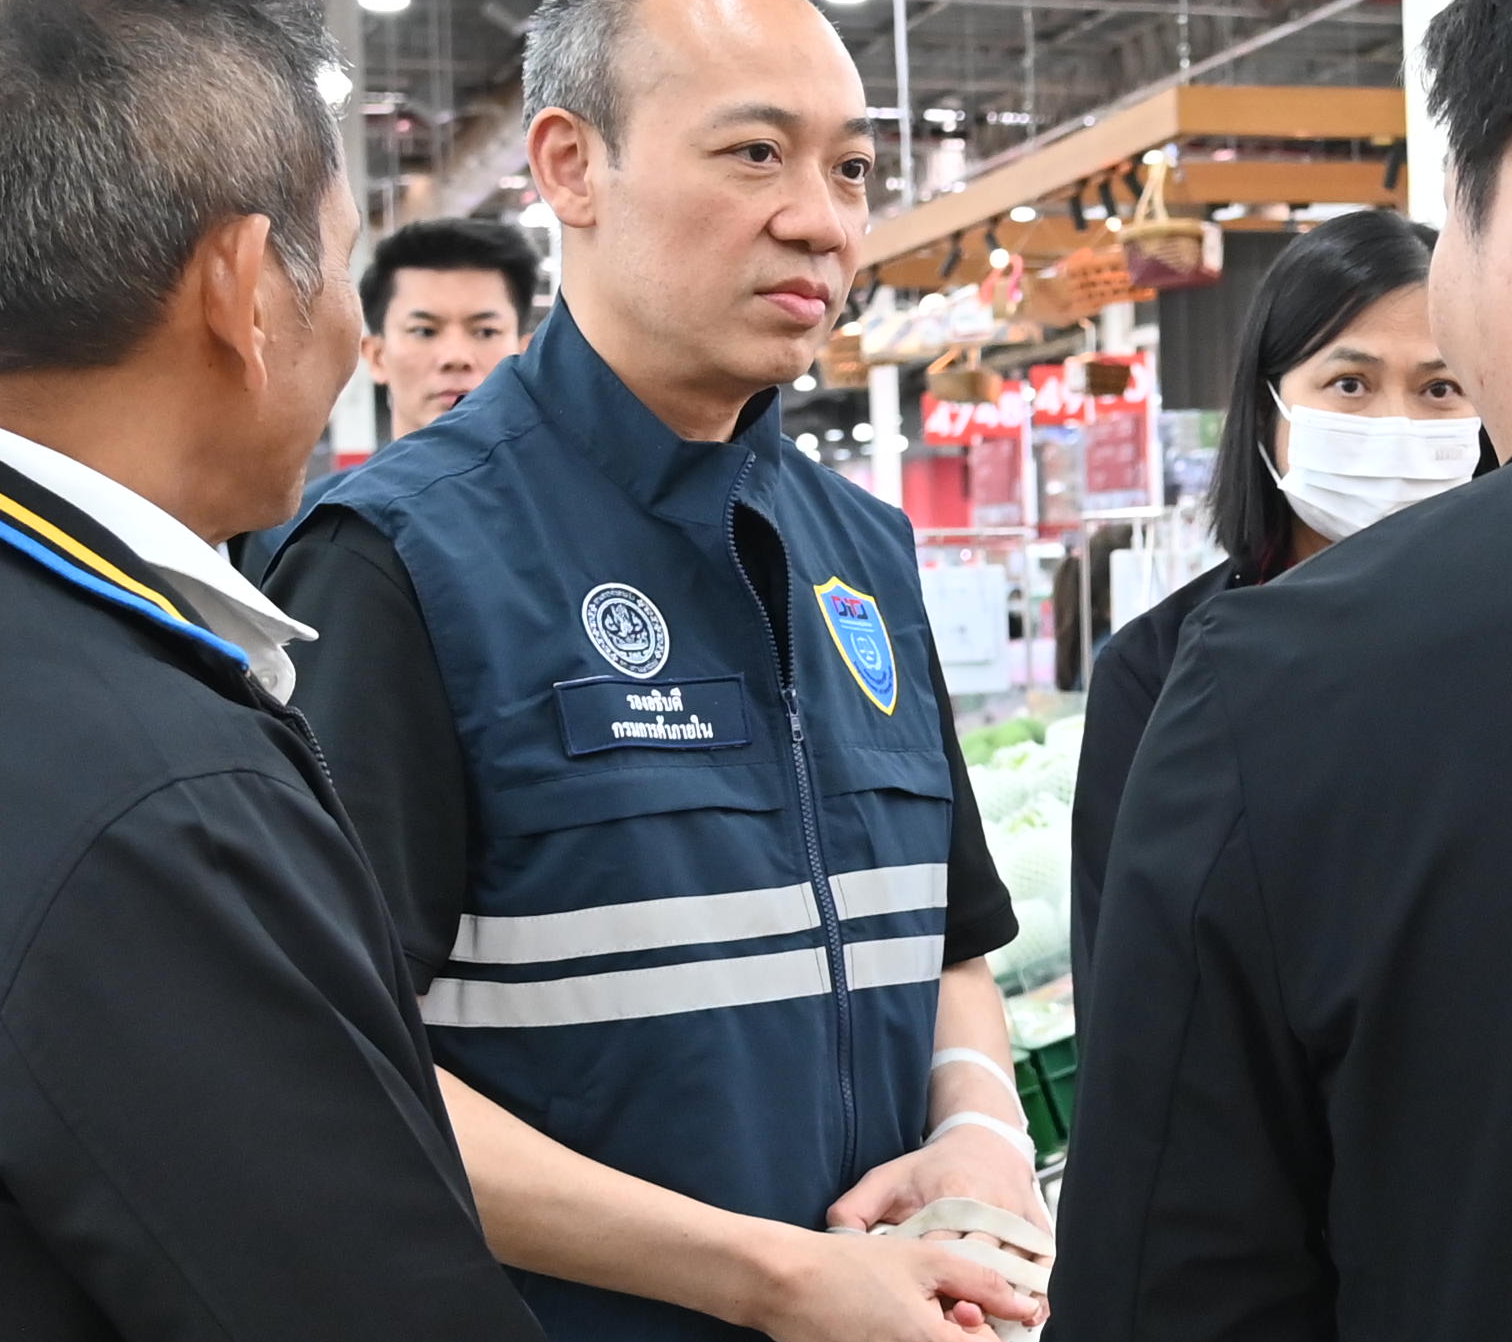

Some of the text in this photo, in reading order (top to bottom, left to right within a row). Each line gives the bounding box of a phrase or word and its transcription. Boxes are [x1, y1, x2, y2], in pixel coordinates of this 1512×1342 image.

[626, 686, 684, 712] รองอธิบดี
[611, 714, 714, 741] กรมการค้าภายใน
